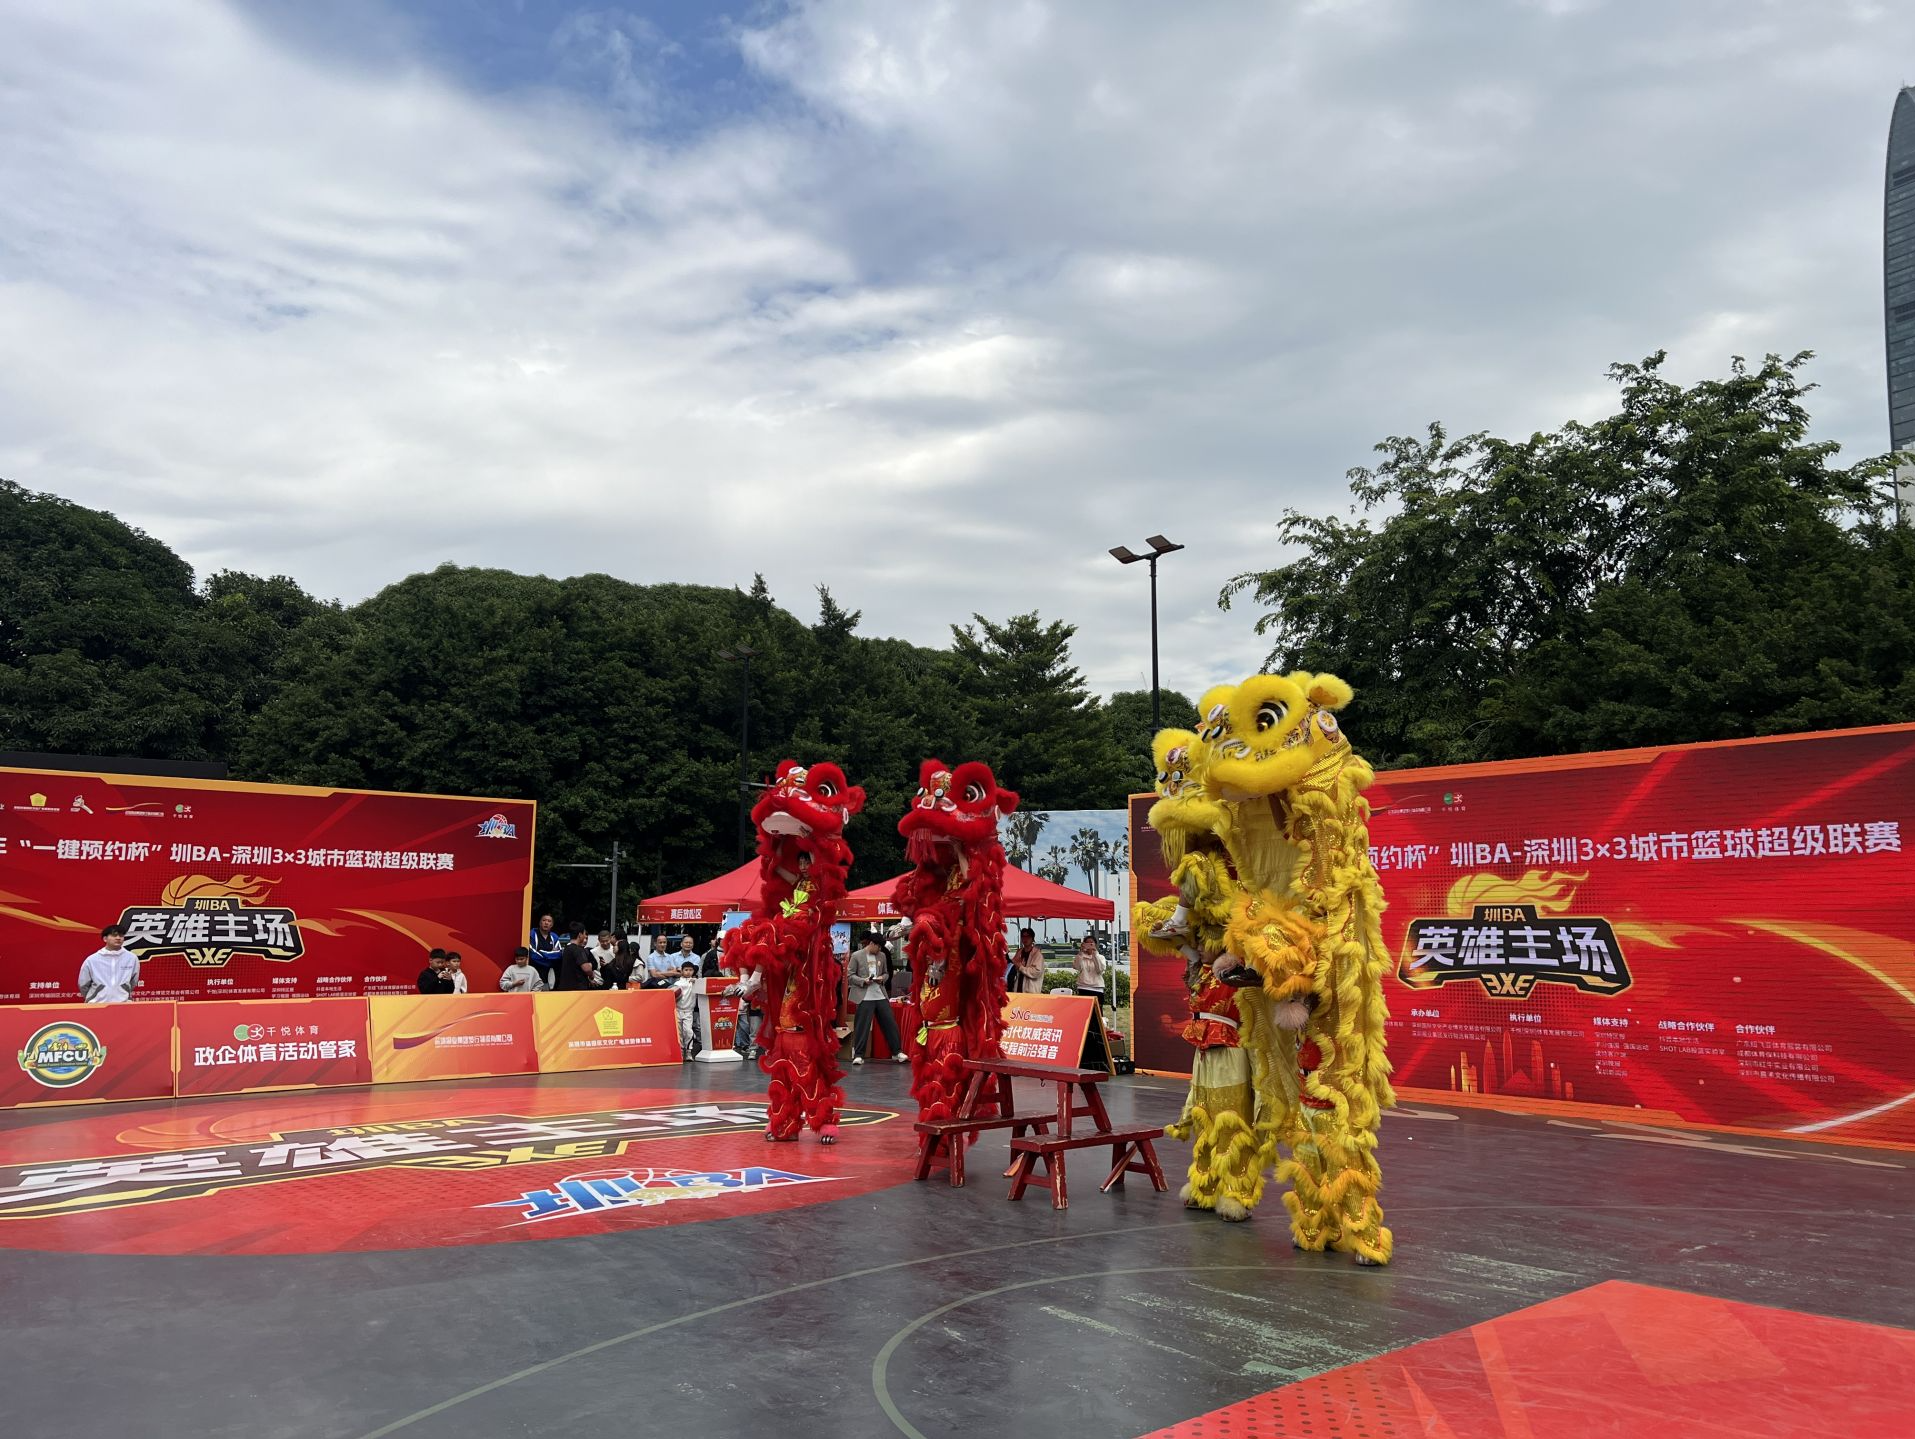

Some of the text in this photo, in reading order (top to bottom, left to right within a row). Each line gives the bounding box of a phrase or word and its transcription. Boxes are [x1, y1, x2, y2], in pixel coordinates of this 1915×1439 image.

[194, 899, 231, 911] 圳BA
[877, 902, 900, 914] 体育
[1483, 908, 1527, 922] 圳BA
[123, 912, 295, 948] 英雄主场
[1408, 925, 1618, 975] 英雄主场
[1010, 1010, 1030, 1021] SNG
[1593, 1016, 1629, 1028] 媒体支持
[1657, 1020, 1716, 1033] 战略合作伙伴
[266, 1025, 320, 1037] 千悦体育
[1735, 1024, 1776, 1035] 合作伙伴
[37, 1050, 88, 1064] MFCU
[193, 1039, 357, 1067] 政企体育活动管家
